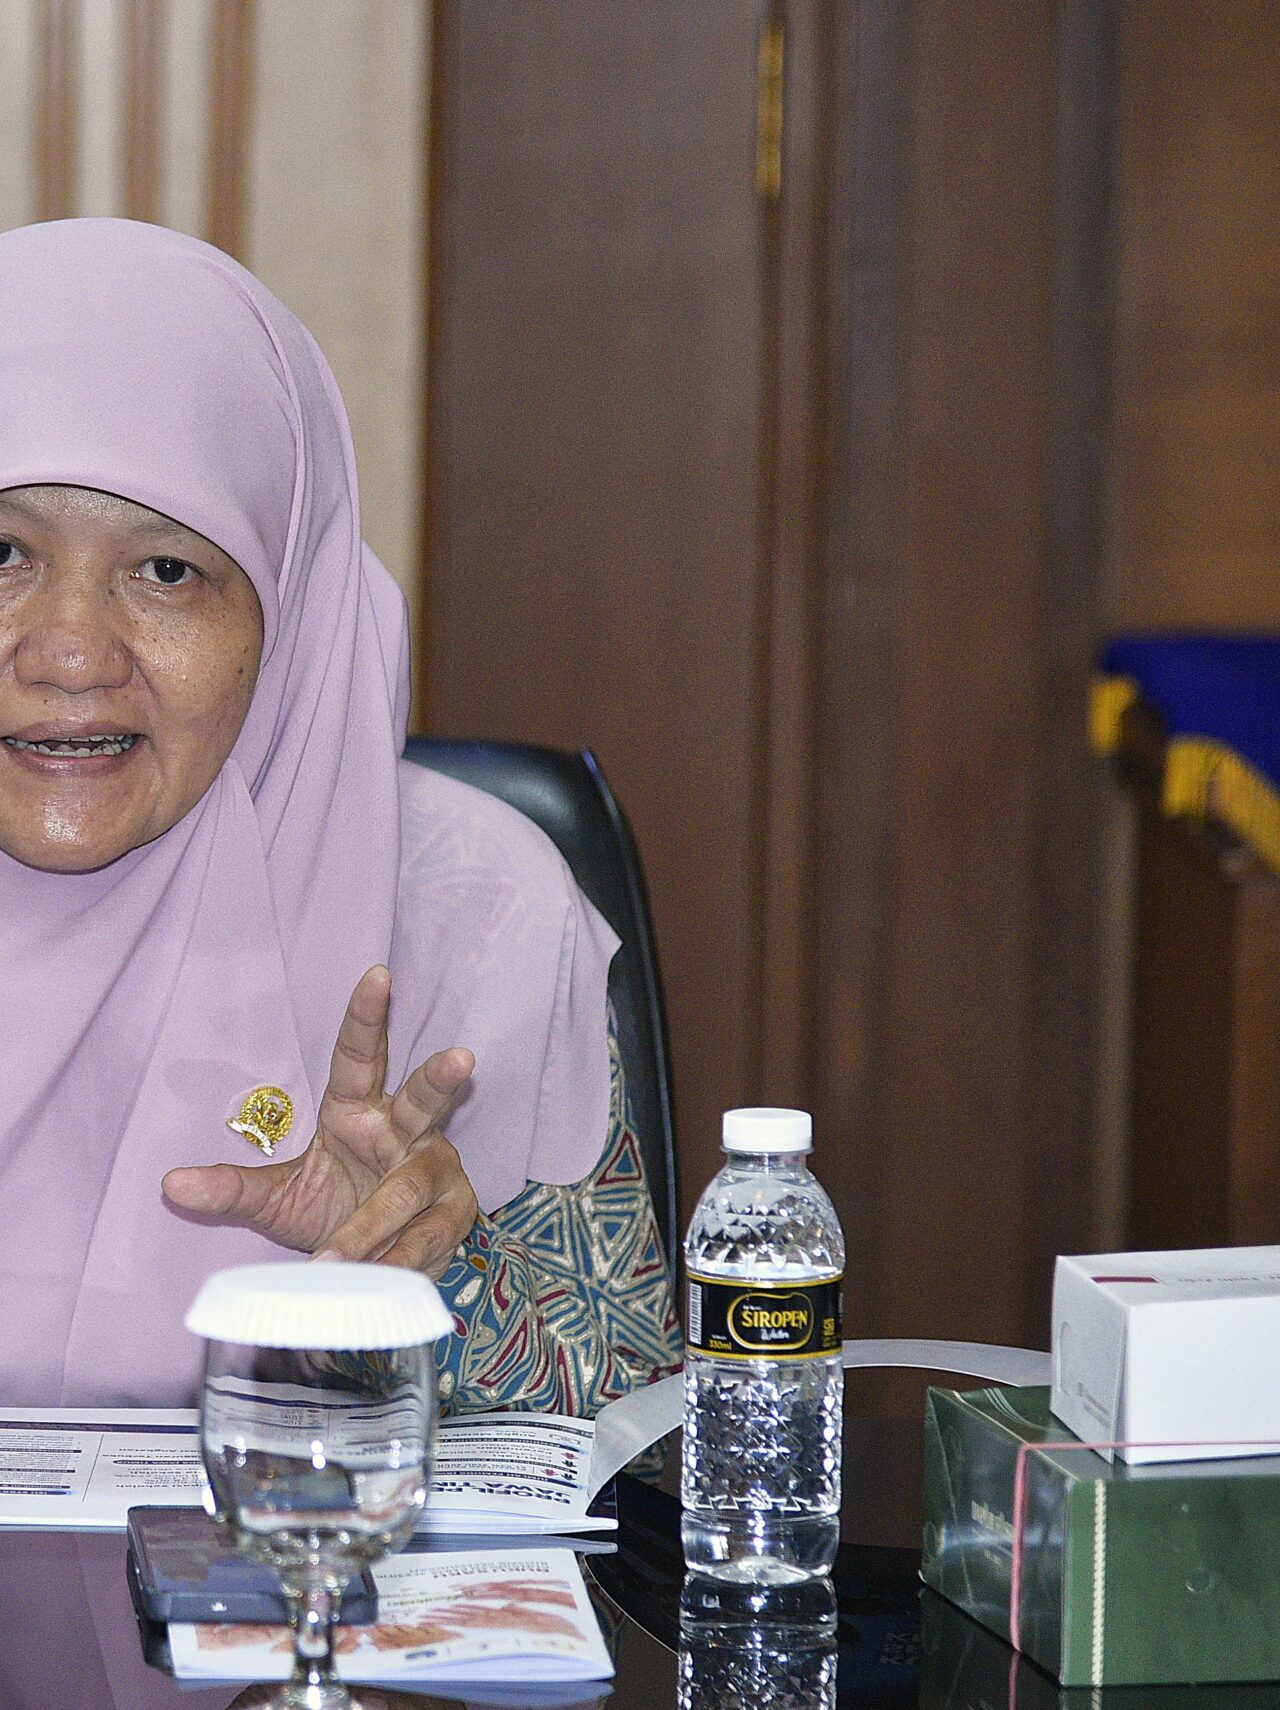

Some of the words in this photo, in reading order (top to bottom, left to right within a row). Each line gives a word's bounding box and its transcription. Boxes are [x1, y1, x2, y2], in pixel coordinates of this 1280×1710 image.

[741, 1310, 808, 1329] SIROPEN
[472, 1488, 570, 1505] PROFIL
[484, 1482, 571, 1497] JAWA
